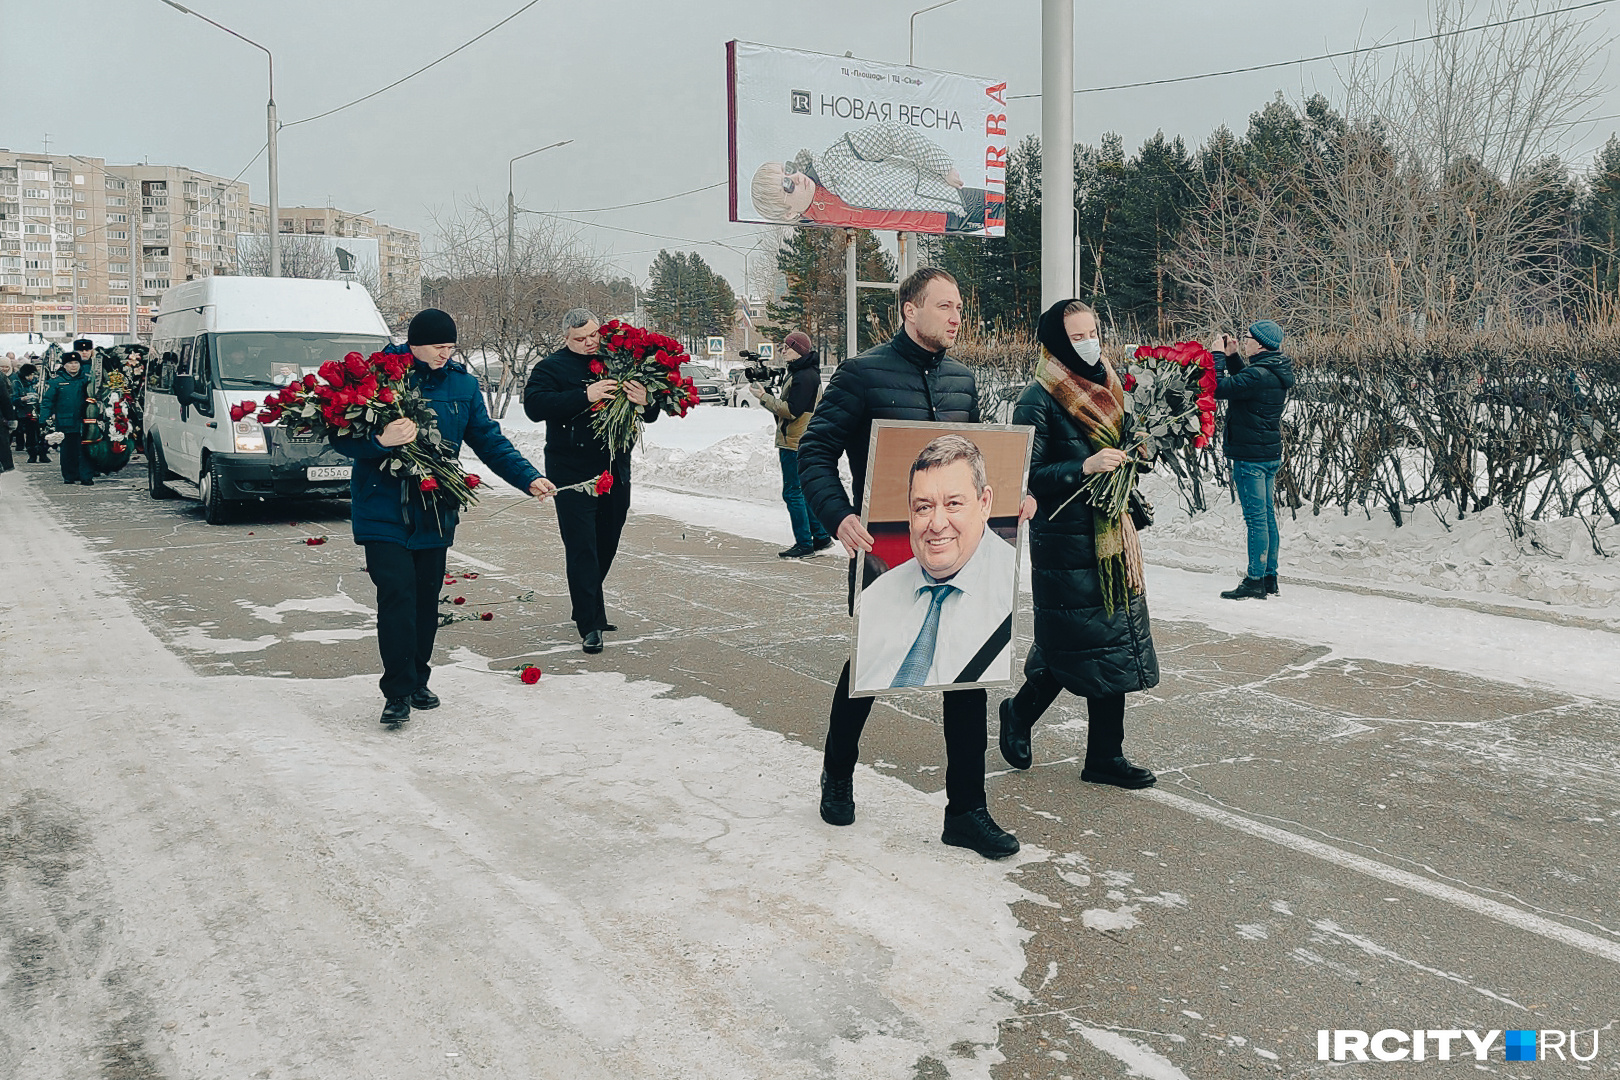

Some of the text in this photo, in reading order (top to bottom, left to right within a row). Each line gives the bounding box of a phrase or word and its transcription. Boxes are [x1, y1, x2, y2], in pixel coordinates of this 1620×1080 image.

[841, 67, 850, 76] ТЦ
[892, 74, 900, 83] ТЦ
[820, 94, 964, 132] НОВАЯ ВЕСНА
